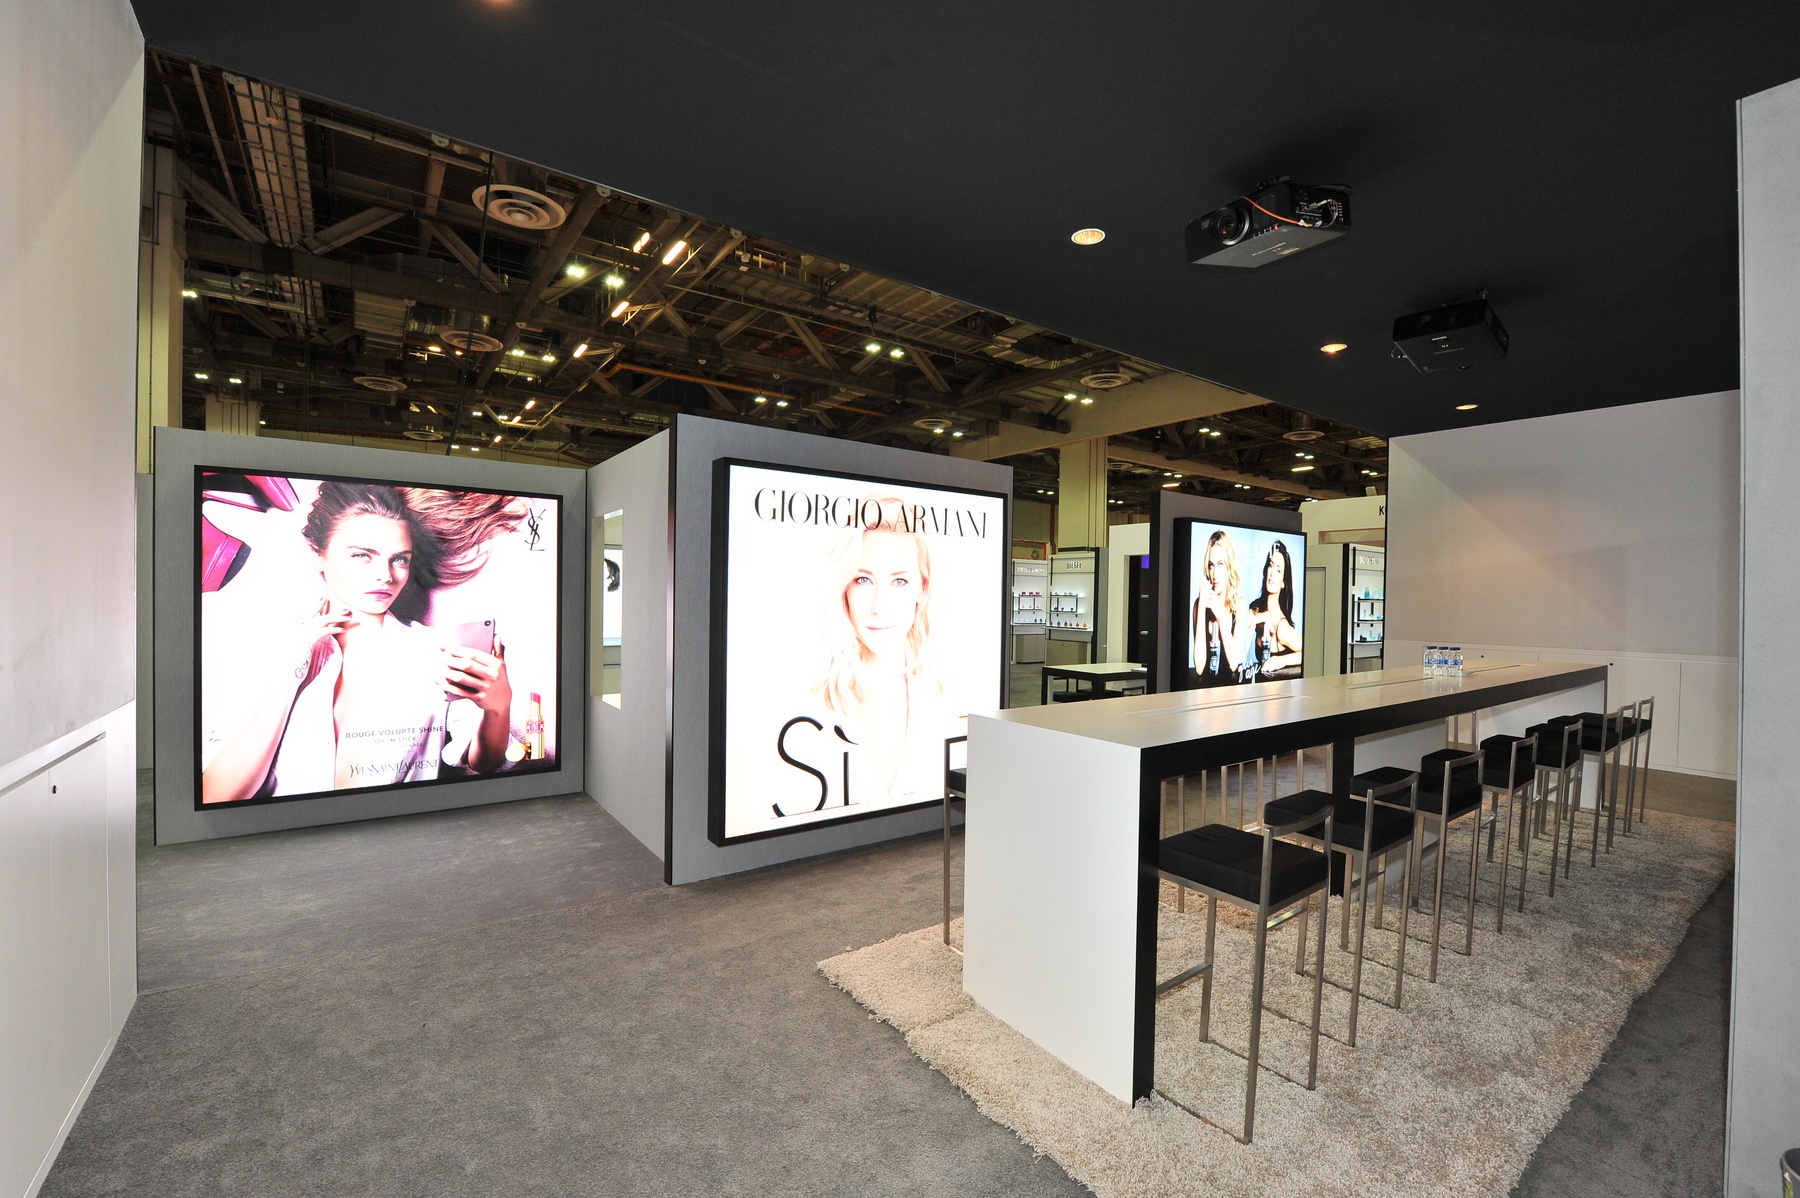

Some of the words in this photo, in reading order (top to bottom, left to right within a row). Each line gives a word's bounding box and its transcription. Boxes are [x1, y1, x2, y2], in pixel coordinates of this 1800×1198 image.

[524, 508, 547, 551] YSL
[754, 487, 883, 531] GIORGIO
[892, 503, 987, 539] ARMANI
